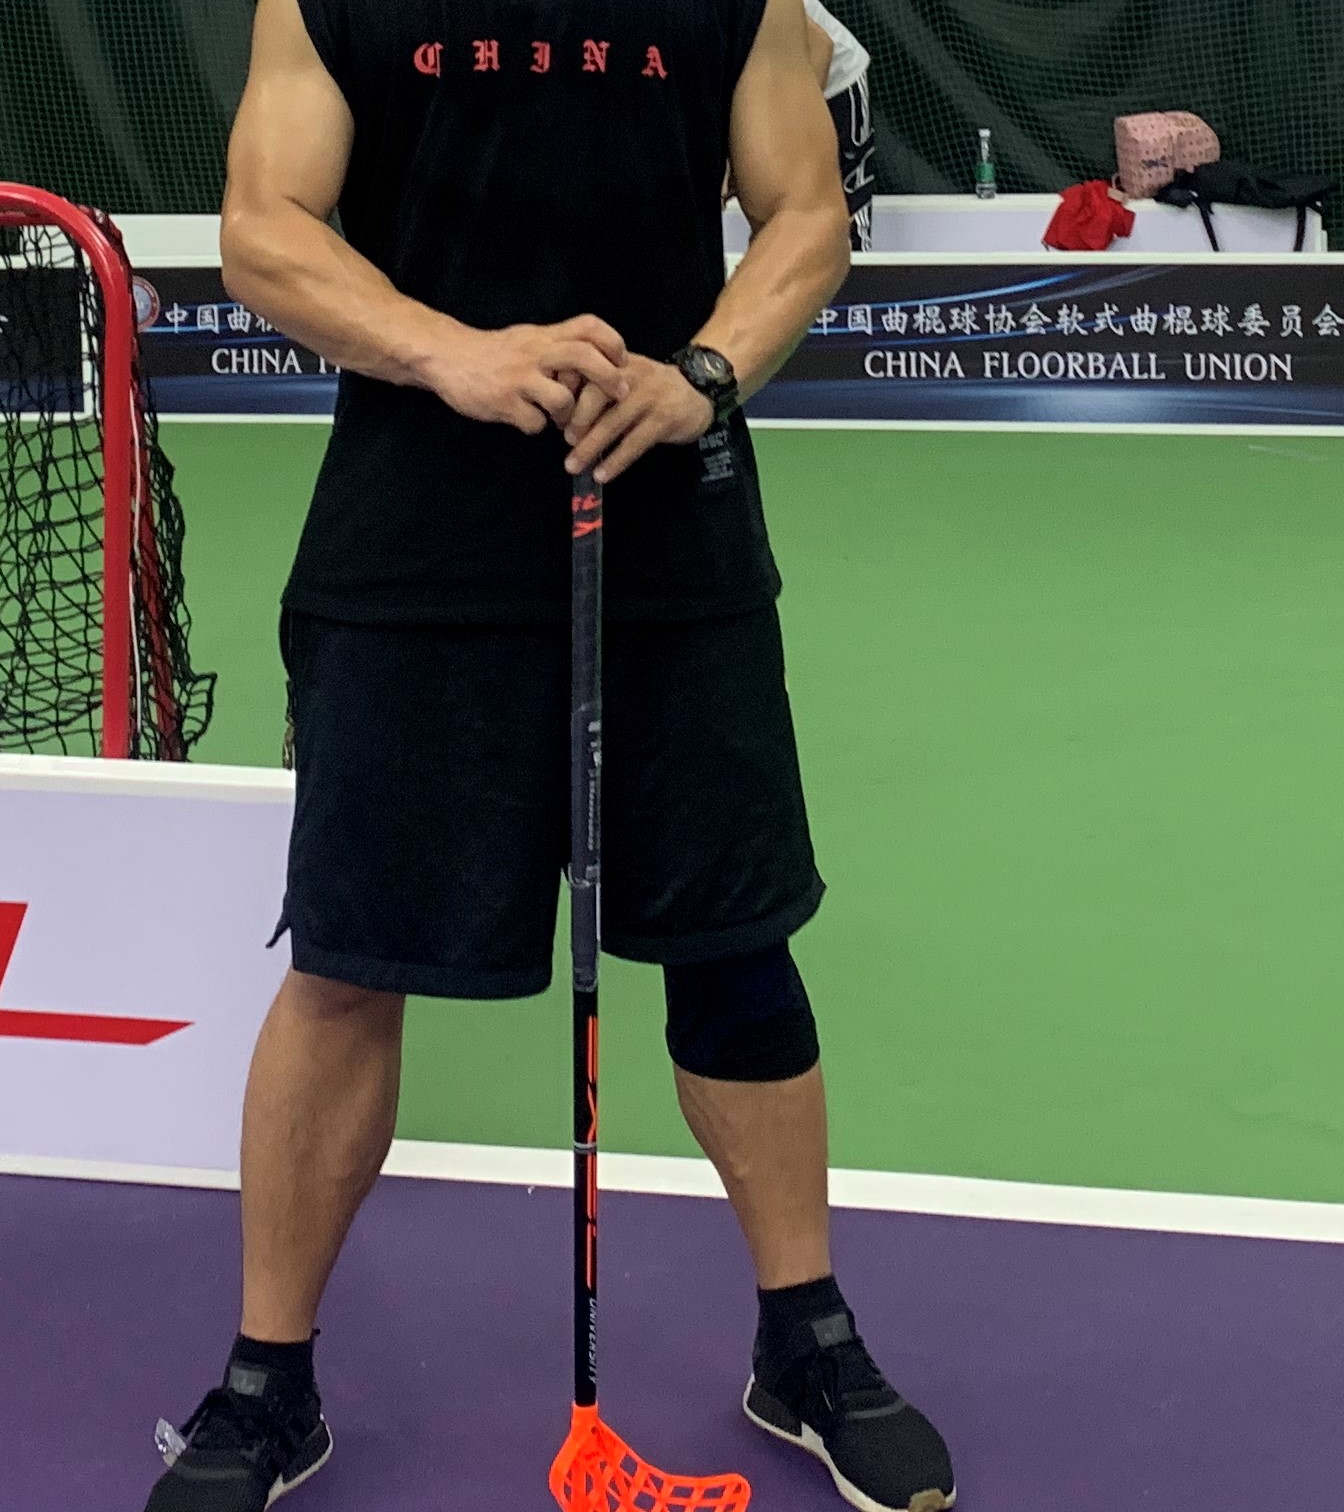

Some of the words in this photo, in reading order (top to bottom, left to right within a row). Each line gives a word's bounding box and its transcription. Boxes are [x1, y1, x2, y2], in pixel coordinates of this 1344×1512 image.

[413, 38, 668, 79] CHINA
[211, 348, 301, 374] CHINA
[864, 350, 965, 378] CHINA
[983, 350, 1166, 380] FLOORBALL
[1183, 352, 1293, 381] UNION
